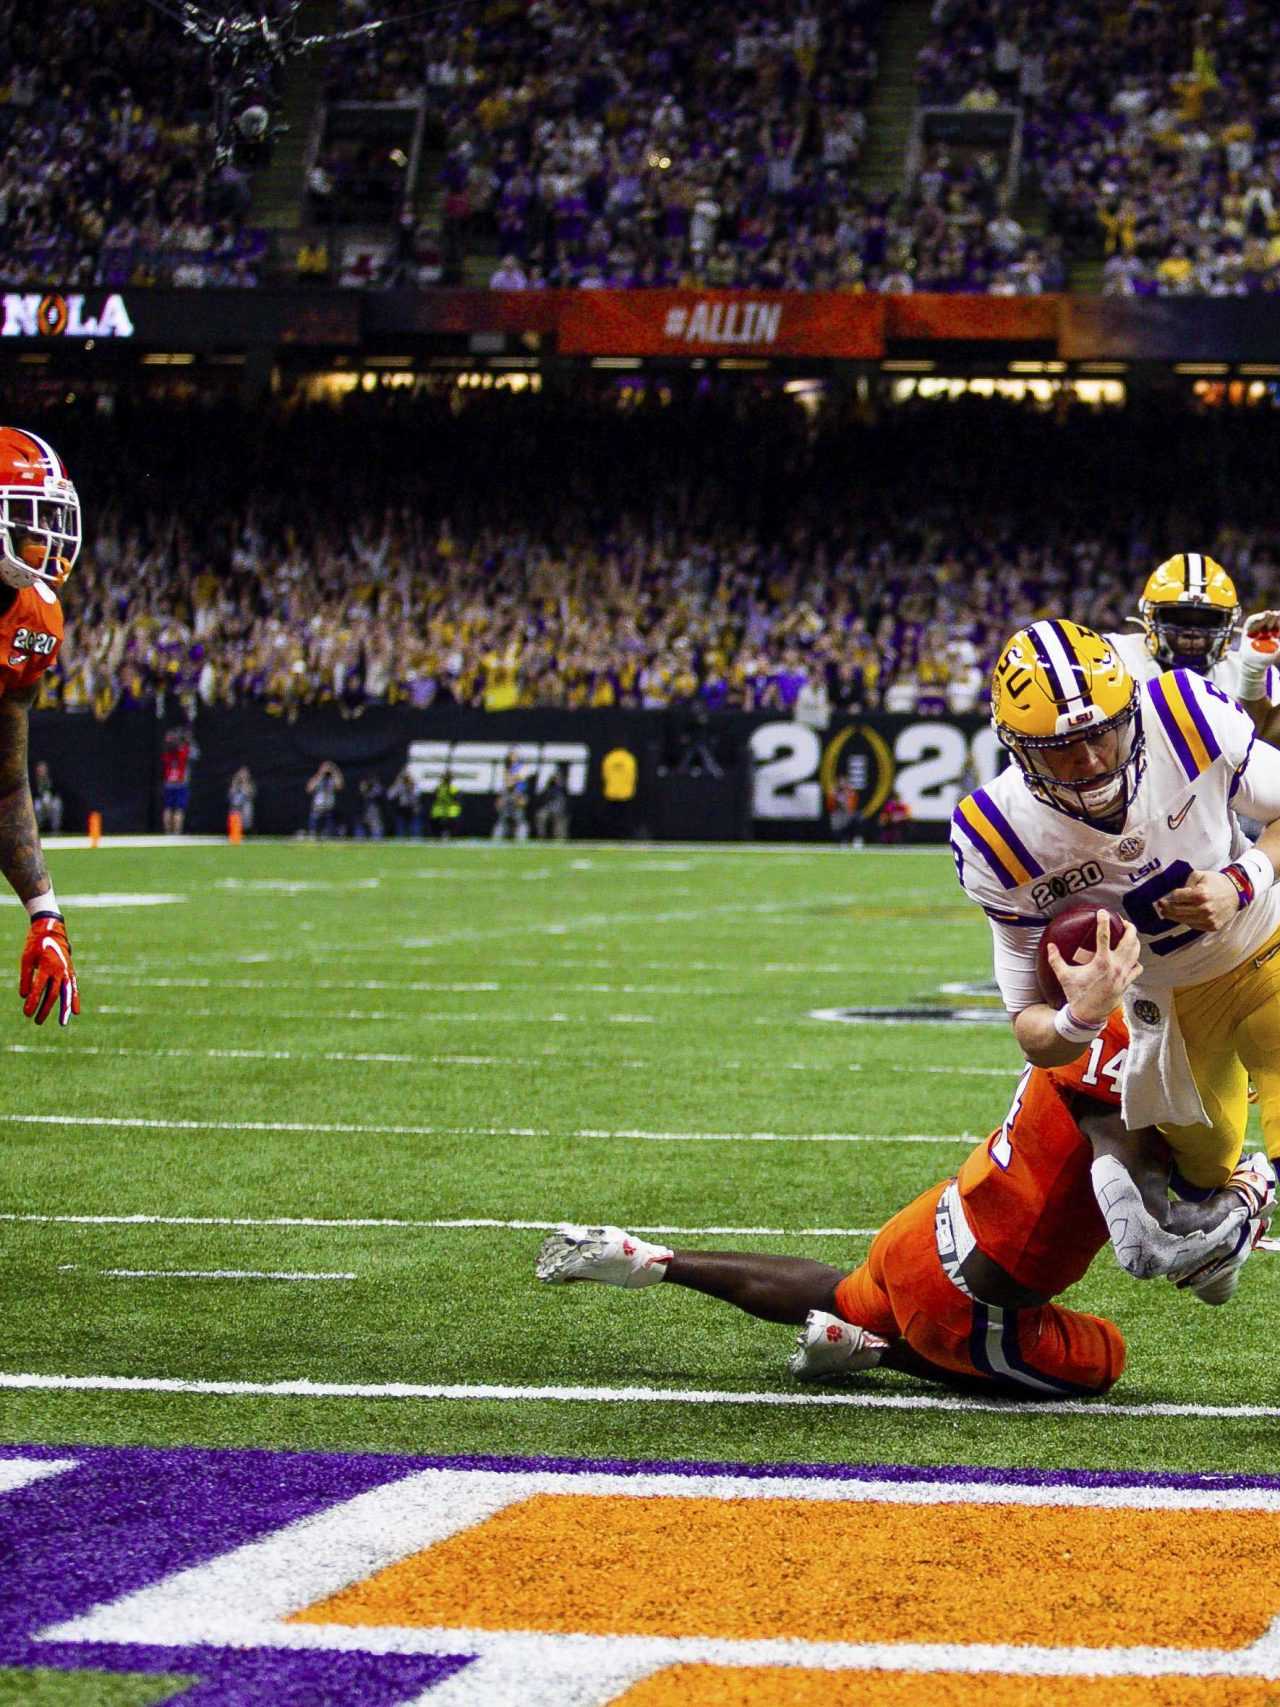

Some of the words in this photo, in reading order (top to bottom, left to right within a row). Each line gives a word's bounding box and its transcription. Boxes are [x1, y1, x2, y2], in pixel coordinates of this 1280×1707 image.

[2, 293, 134, 336] NOLA
[1067, 710, 1094, 726] LSU
[407, 740, 590, 796] ESPN
[1031, 861, 1104, 910] 2020
[1128, 857, 1161, 883] LSU
[1081, 1038, 1133, 1094] 14
